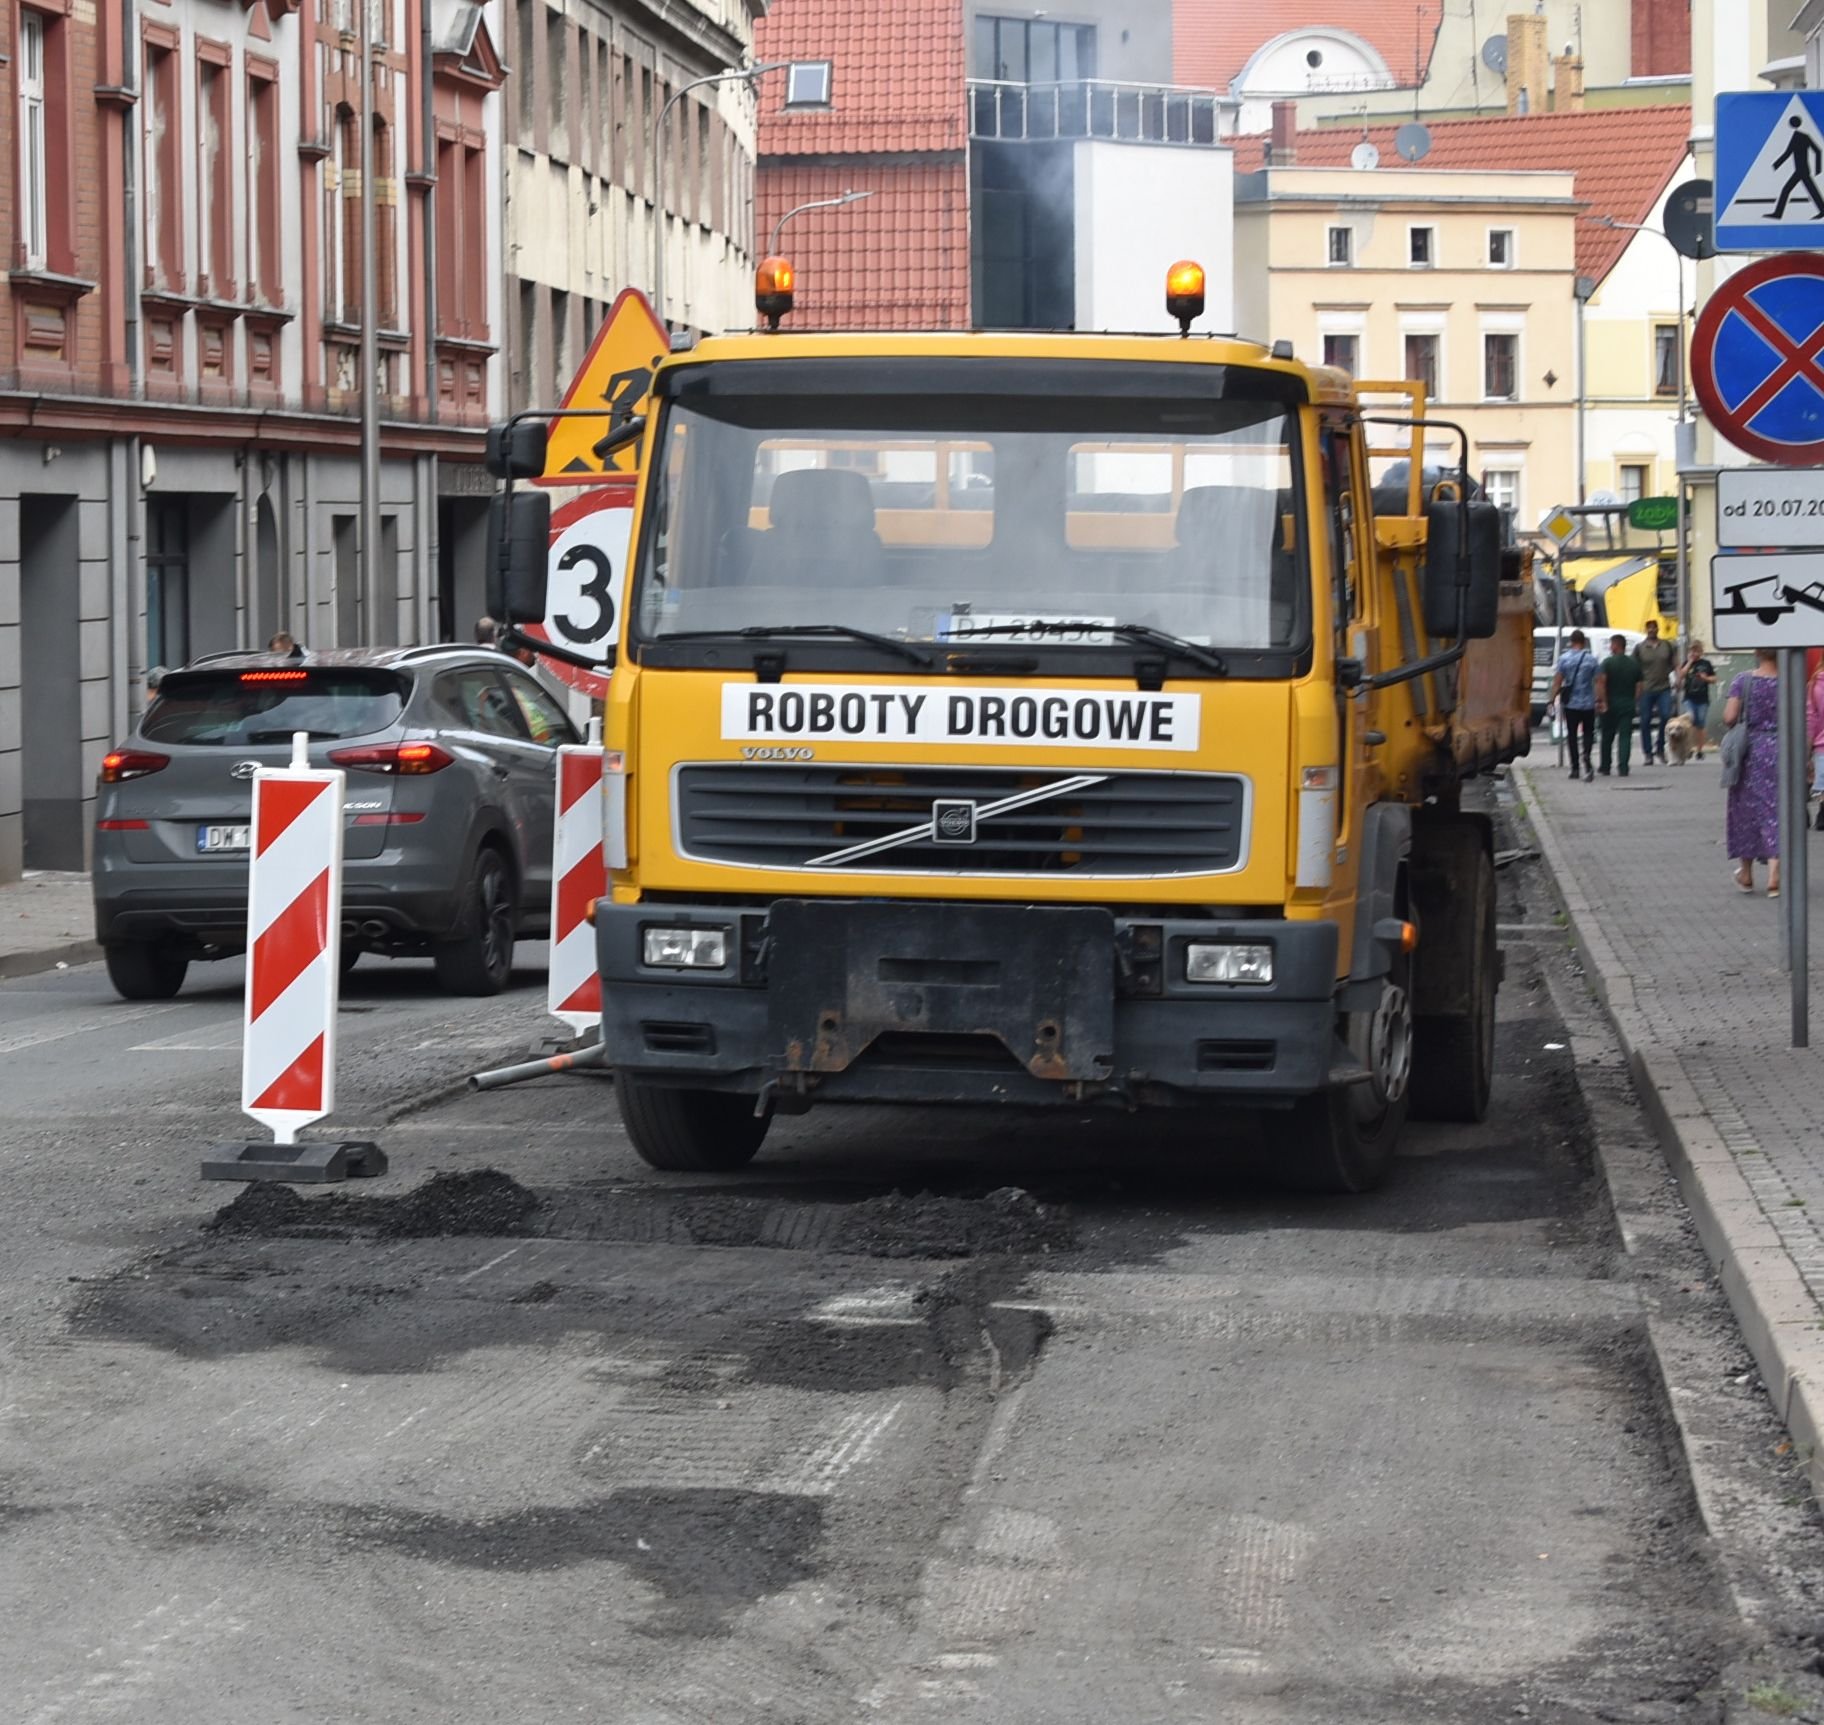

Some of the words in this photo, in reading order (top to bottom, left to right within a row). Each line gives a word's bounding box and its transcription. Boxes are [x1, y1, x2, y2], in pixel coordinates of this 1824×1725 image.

[1723, 499, 1746, 517] od
[553, 544, 614, 644] 3
[748, 691, 927, 735] ROBOTY
[947, 695, 1174, 742] DROGOWE
[741, 747, 815, 760] VOLVO
[211, 828, 234, 846] DW
